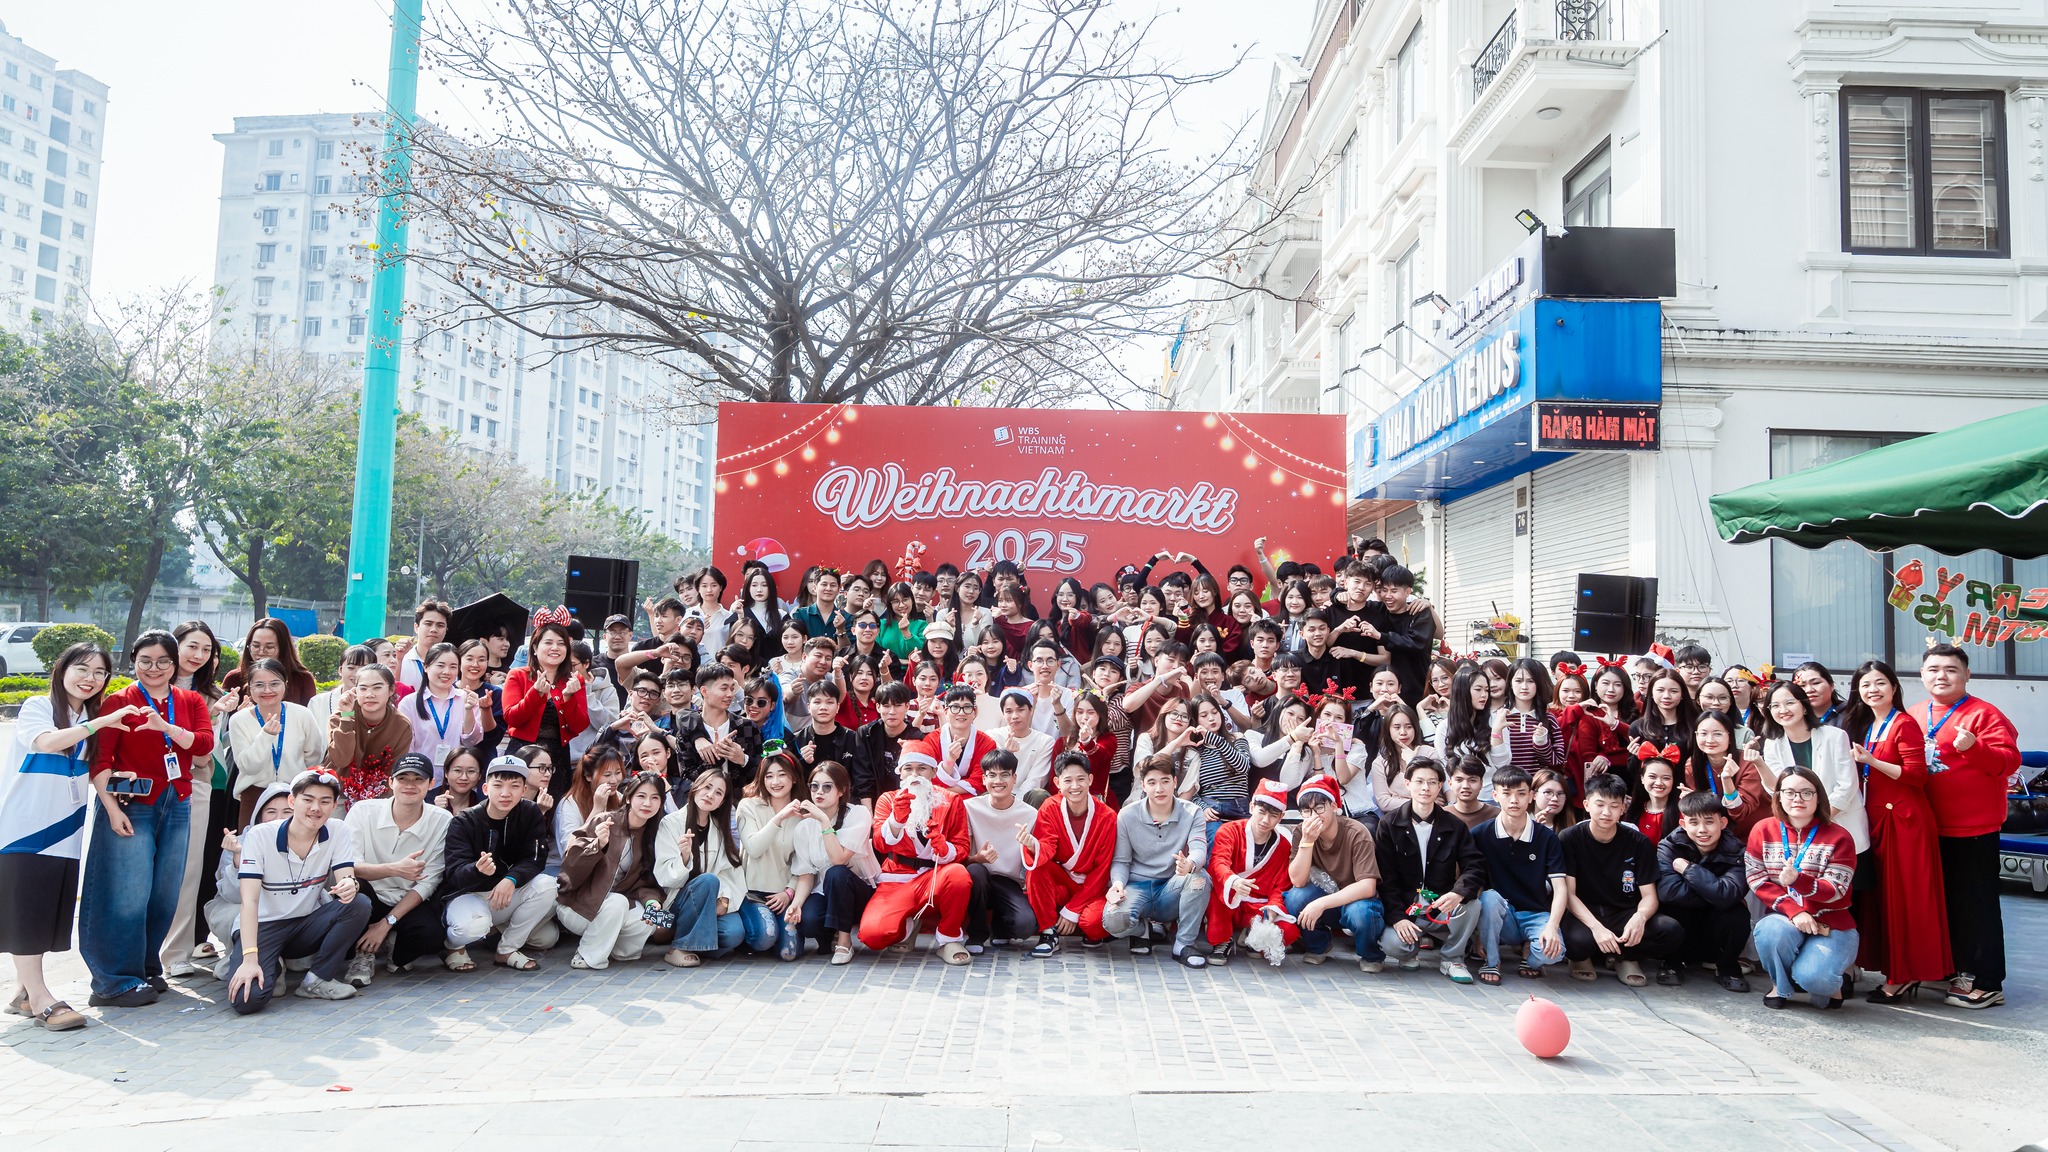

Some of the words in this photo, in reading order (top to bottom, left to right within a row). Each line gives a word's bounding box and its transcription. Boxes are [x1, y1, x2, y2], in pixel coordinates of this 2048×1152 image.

[1386, 405, 1414, 460] NHA
[1415, 374, 1458, 443] KHOA
[1454, 330, 1520, 418] VENUS
[1018, 436, 1066, 444] TRAINING
[1542, 409, 1582, 439] RĂNG
[1586, 410, 1619, 440] HÀM
[1623, 411, 1655, 447] MẶT
[1018, 446, 1064, 454] VIETNAM
[813, 462, 1238, 534] Weihnachtsmarkt
[963, 528, 1088, 574] 2025
